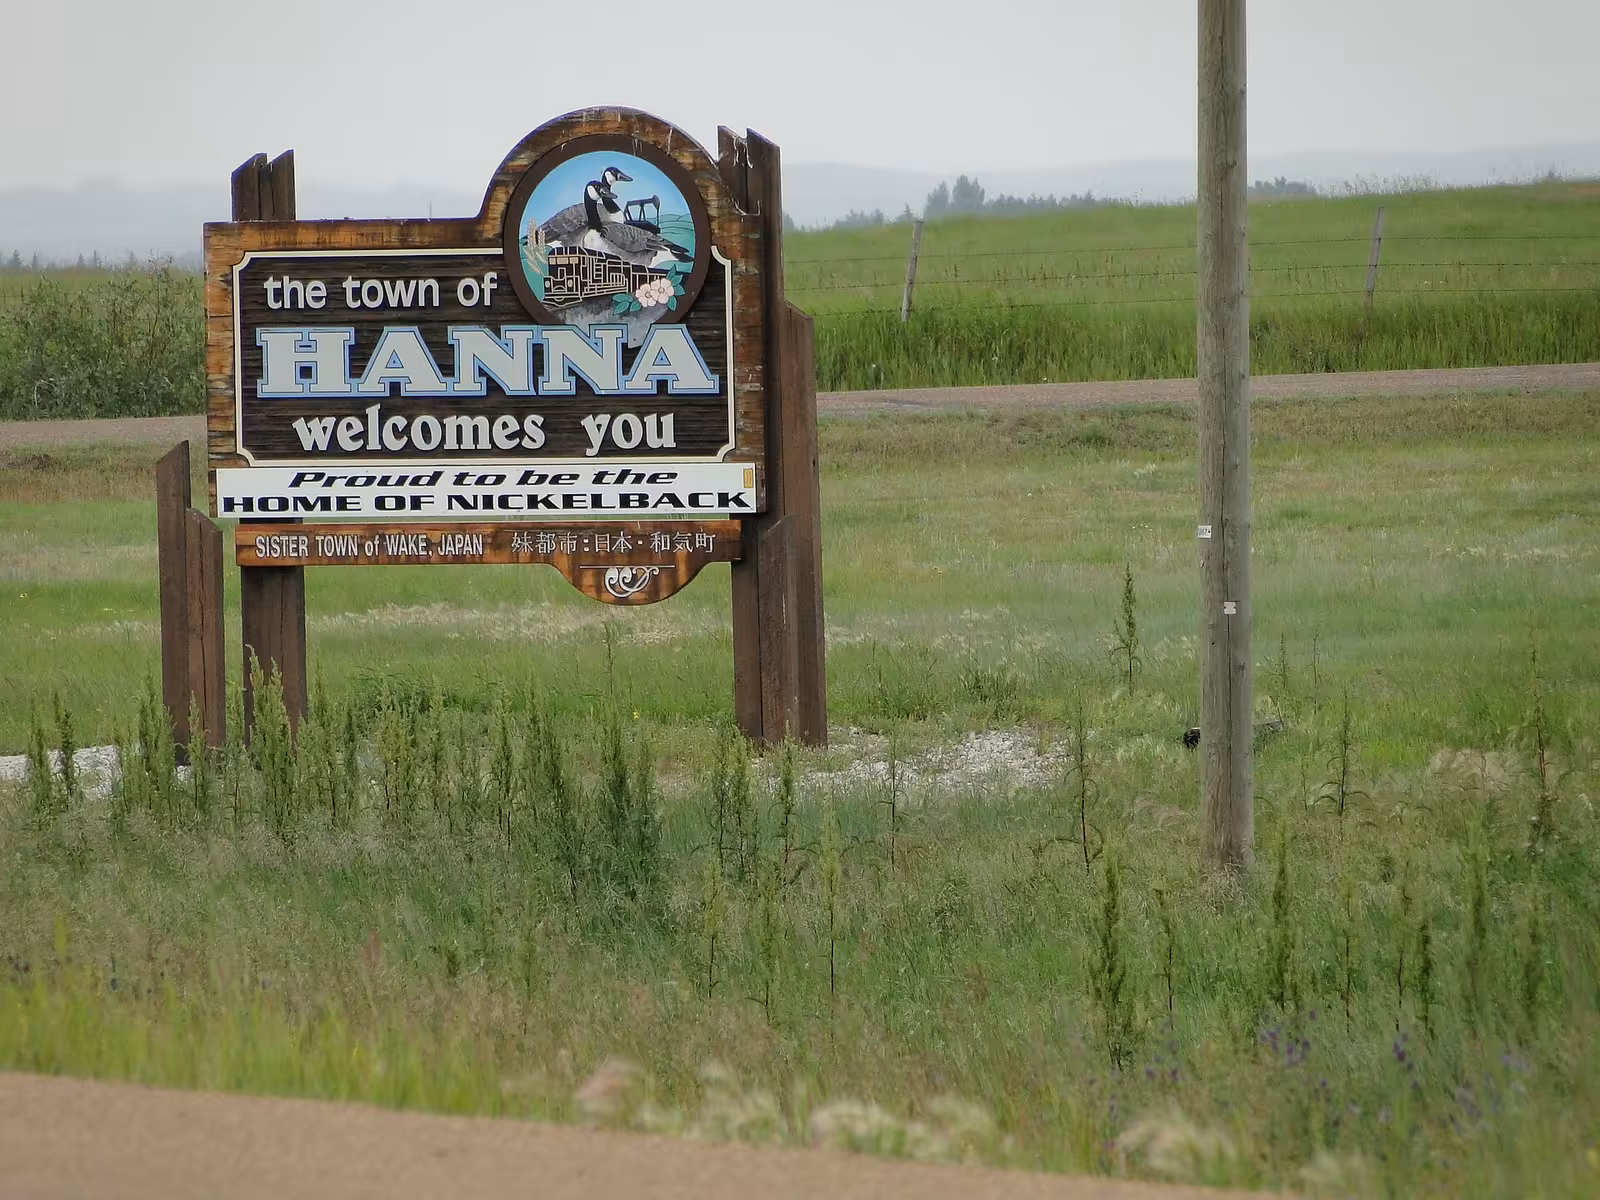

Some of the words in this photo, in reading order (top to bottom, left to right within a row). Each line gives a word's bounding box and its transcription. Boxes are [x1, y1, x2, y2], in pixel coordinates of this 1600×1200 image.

[264, 276, 326, 308] the
[343, 276, 439, 307] town
[457, 272, 497, 306] of
[256, 324, 720, 398] HANNA
[292, 403, 546, 451] welcomes
[581, 412, 676, 455] you
[288, 470, 445, 488] Proud
[453, 470, 508, 487] to
[516, 470, 580, 487] be
[592, 469, 678, 485] the
[223, 496, 362, 513] HOME
[374, 495, 435, 511] OF
[448, 491, 752, 511] NICKELBACK
[255, 535, 309, 557] SISTER
[315, 535, 358, 557] TOWN
[364, 537, 380, 556] of
[385, 534, 433, 557] WAKE,
[437, 533, 483, 555] JAPAN
